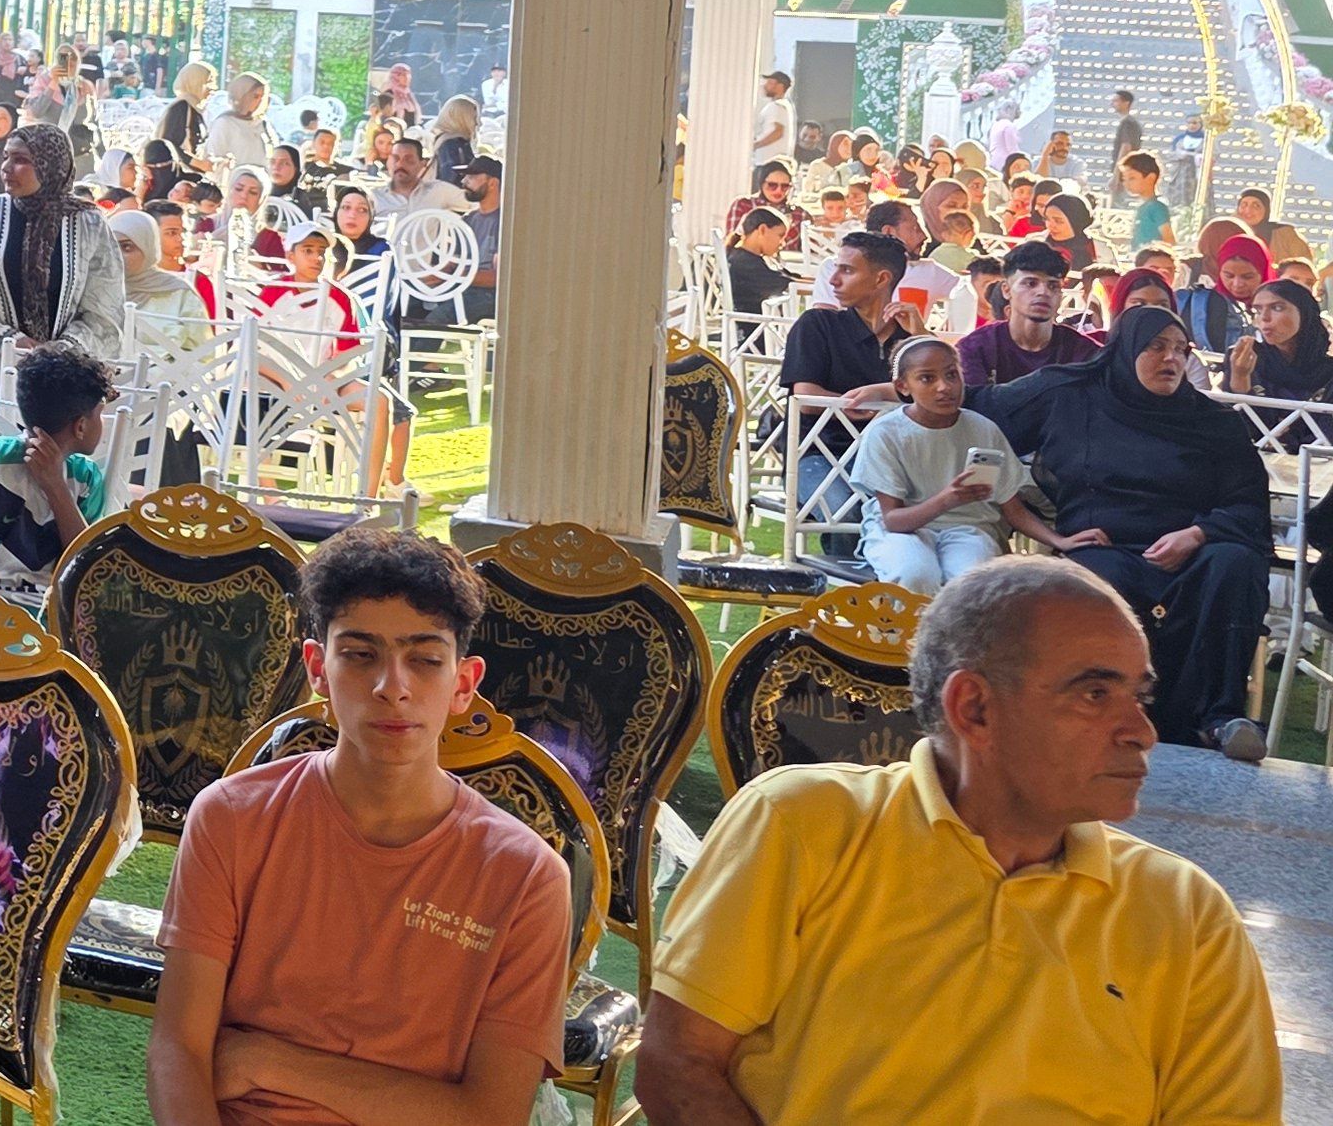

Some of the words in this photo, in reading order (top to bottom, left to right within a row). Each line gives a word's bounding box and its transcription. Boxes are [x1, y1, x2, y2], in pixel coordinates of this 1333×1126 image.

[403, 897, 422, 913] Let
[424, 902, 461, 926] Zion's
[405, 913, 426, 930] Lift
